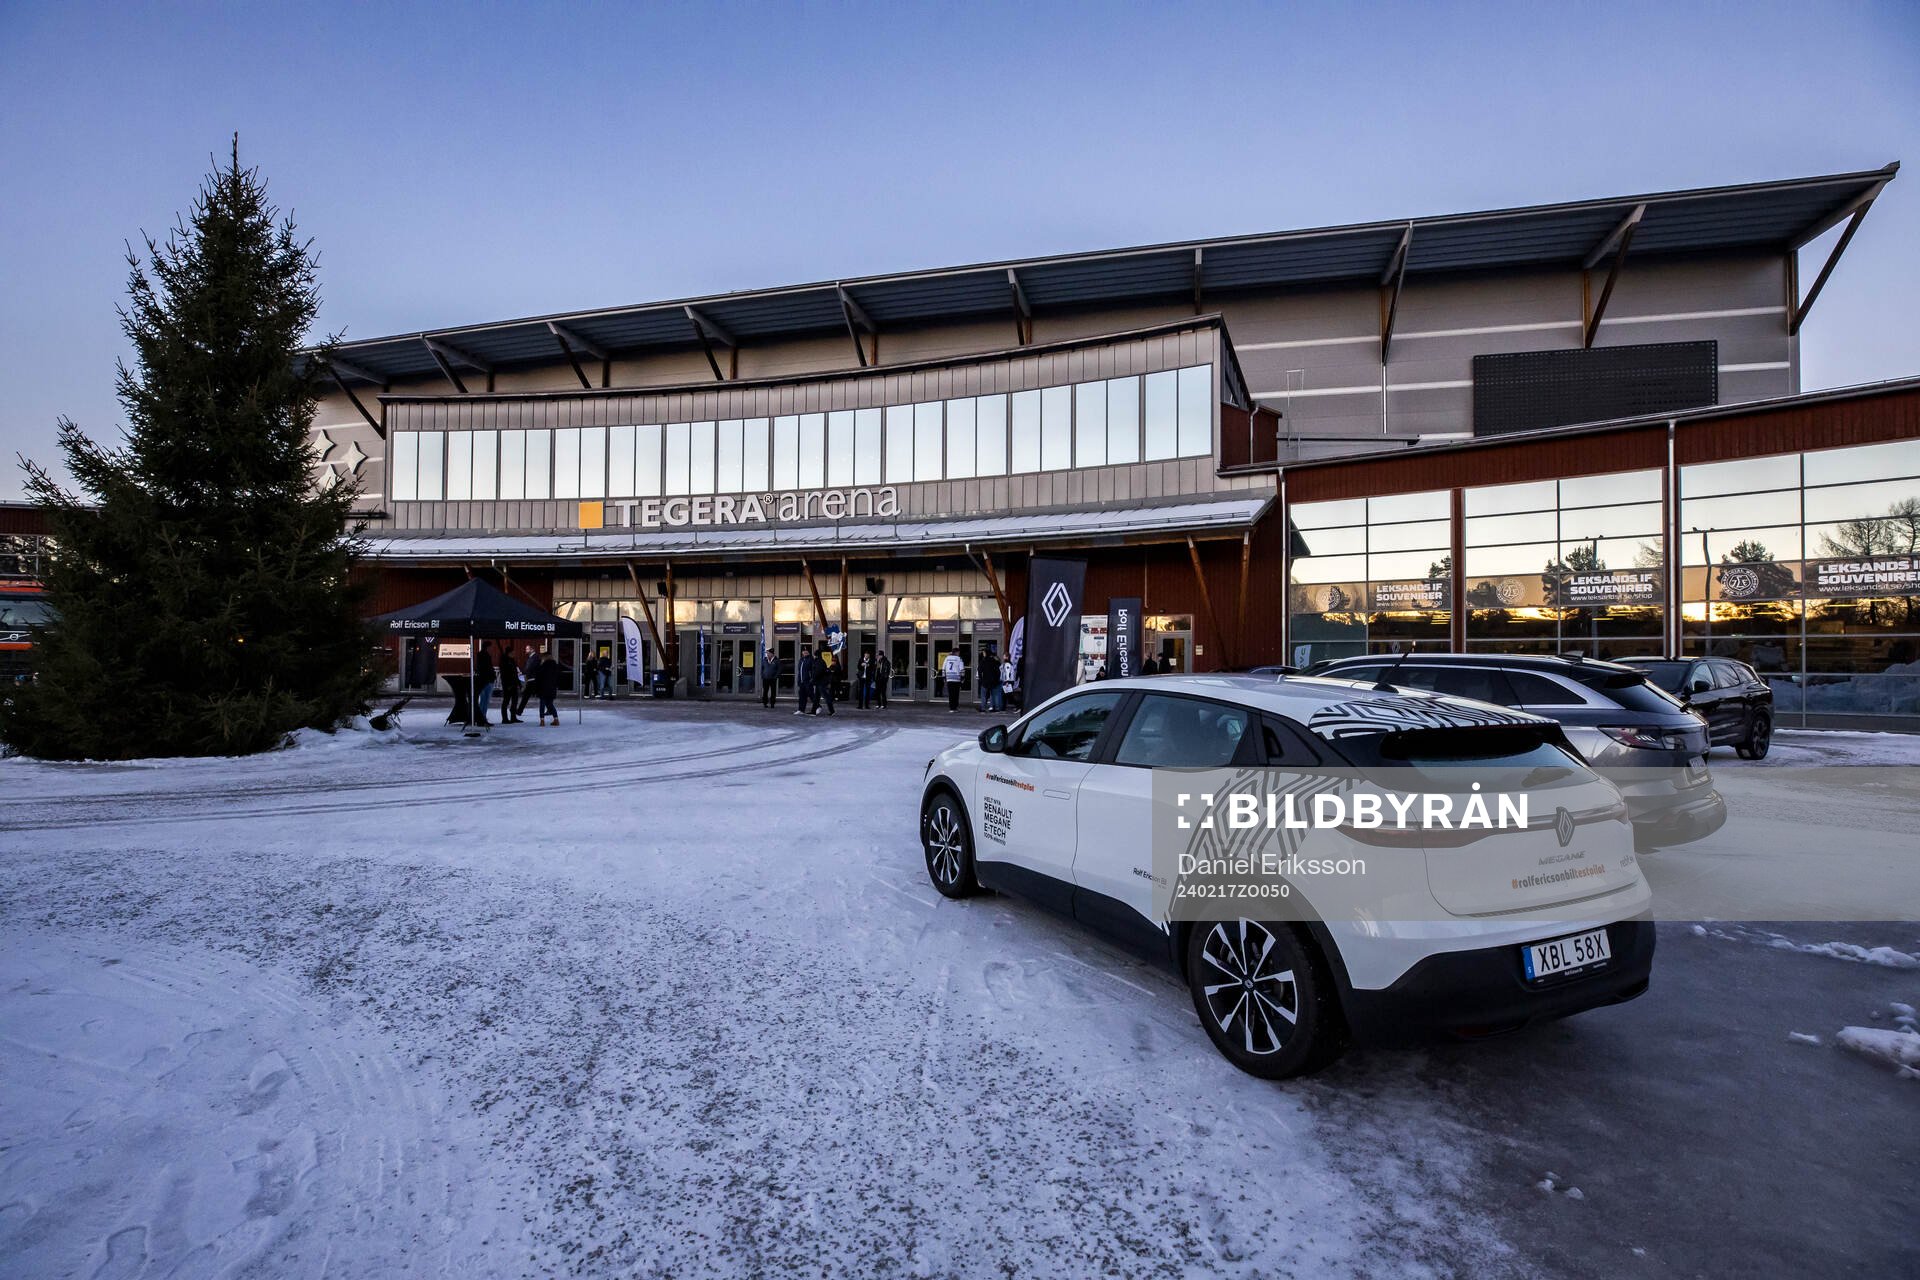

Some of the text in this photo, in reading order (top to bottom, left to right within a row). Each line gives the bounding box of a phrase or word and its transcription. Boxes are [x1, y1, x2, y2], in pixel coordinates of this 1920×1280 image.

[778, 486, 901, 522] arena
[1818, 560, 1920, 574] LEKSANDS I
[1570, 573, 1653, 585] LEKSANDS IF
[1818, 571, 1920, 585] SOUVENIRE
[1376, 583, 1443, 593] LEKSANDS IF
[1570, 583, 1653, 595] SOUVENIRER
[1376, 591, 1443, 601] SOUVENIRER
[390, 620, 403, 629] Rolf
[404, 620, 430, 629] Ericson
[505, 620, 556, 631] Rolf Ericson Bil
[949, 661, 954, 671] 7
[984, 802, 1013, 820] RENAULT
[984, 812, 1011, 830] MEGANE
[984, 822, 1006, 839] E-TECH
[1538, 850, 1586, 866] MEGANE
[1512, 864, 1606, 889] #rolfericsonbiltestpilot
[1537, 933, 1606, 973] XBL 58X
